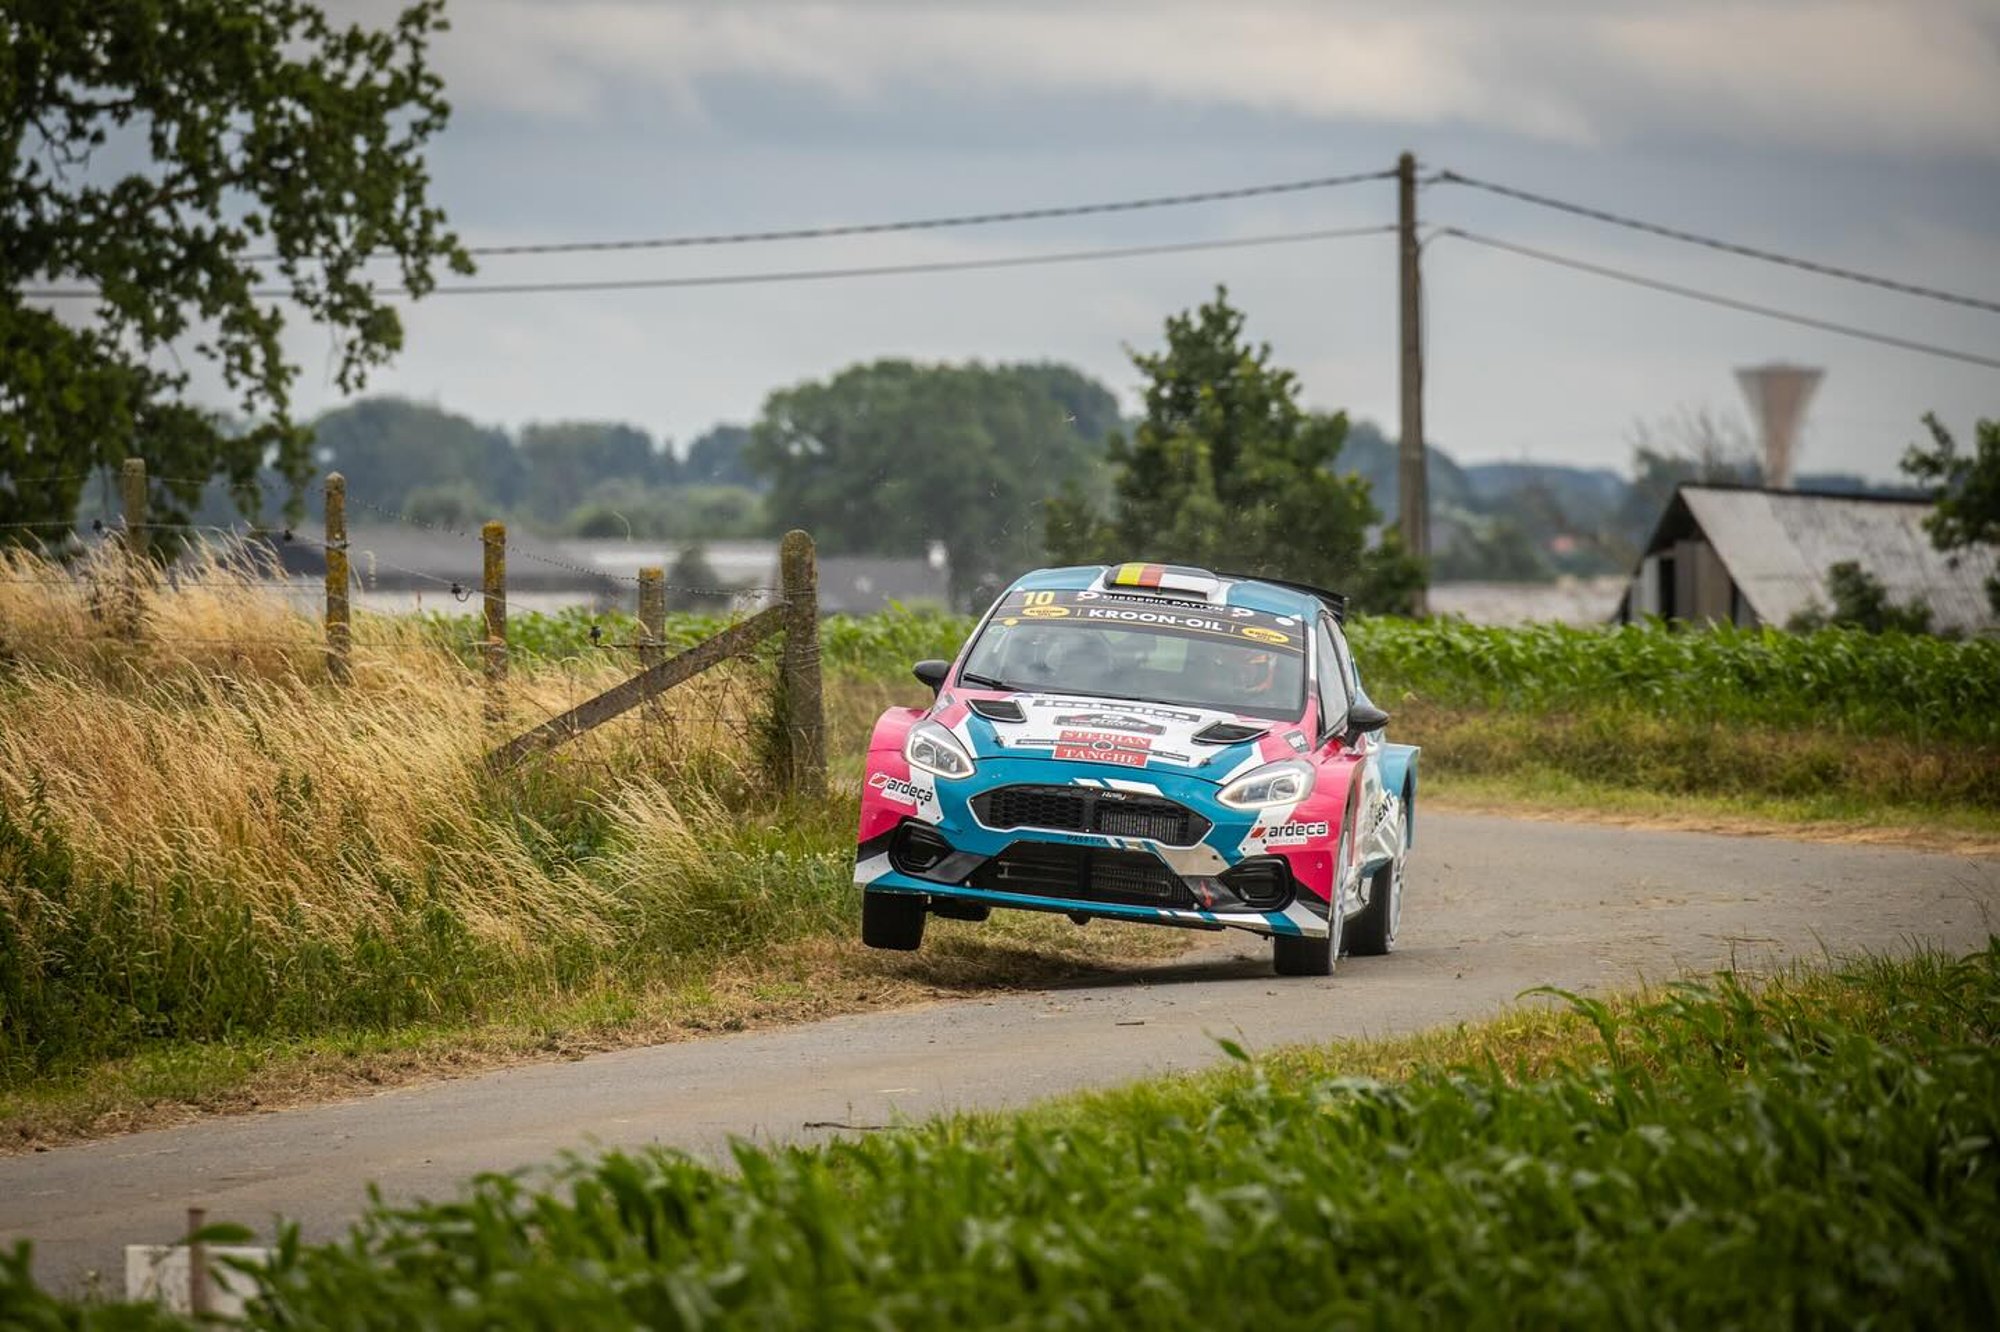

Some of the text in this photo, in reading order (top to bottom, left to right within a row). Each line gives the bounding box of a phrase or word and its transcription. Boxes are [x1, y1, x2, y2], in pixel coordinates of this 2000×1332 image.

[1023, 591, 1055, 606] 10
[1103, 594, 1168, 605] DIEDERIK
[1088, 608, 1223, 631] KROON-OIL
[1064, 730, 1148, 745] STEPHAN
[1063, 749, 1139, 765] TANGHE
[887, 779, 934, 802] ardeca
[1269, 822, 1327, 838] ardeca
